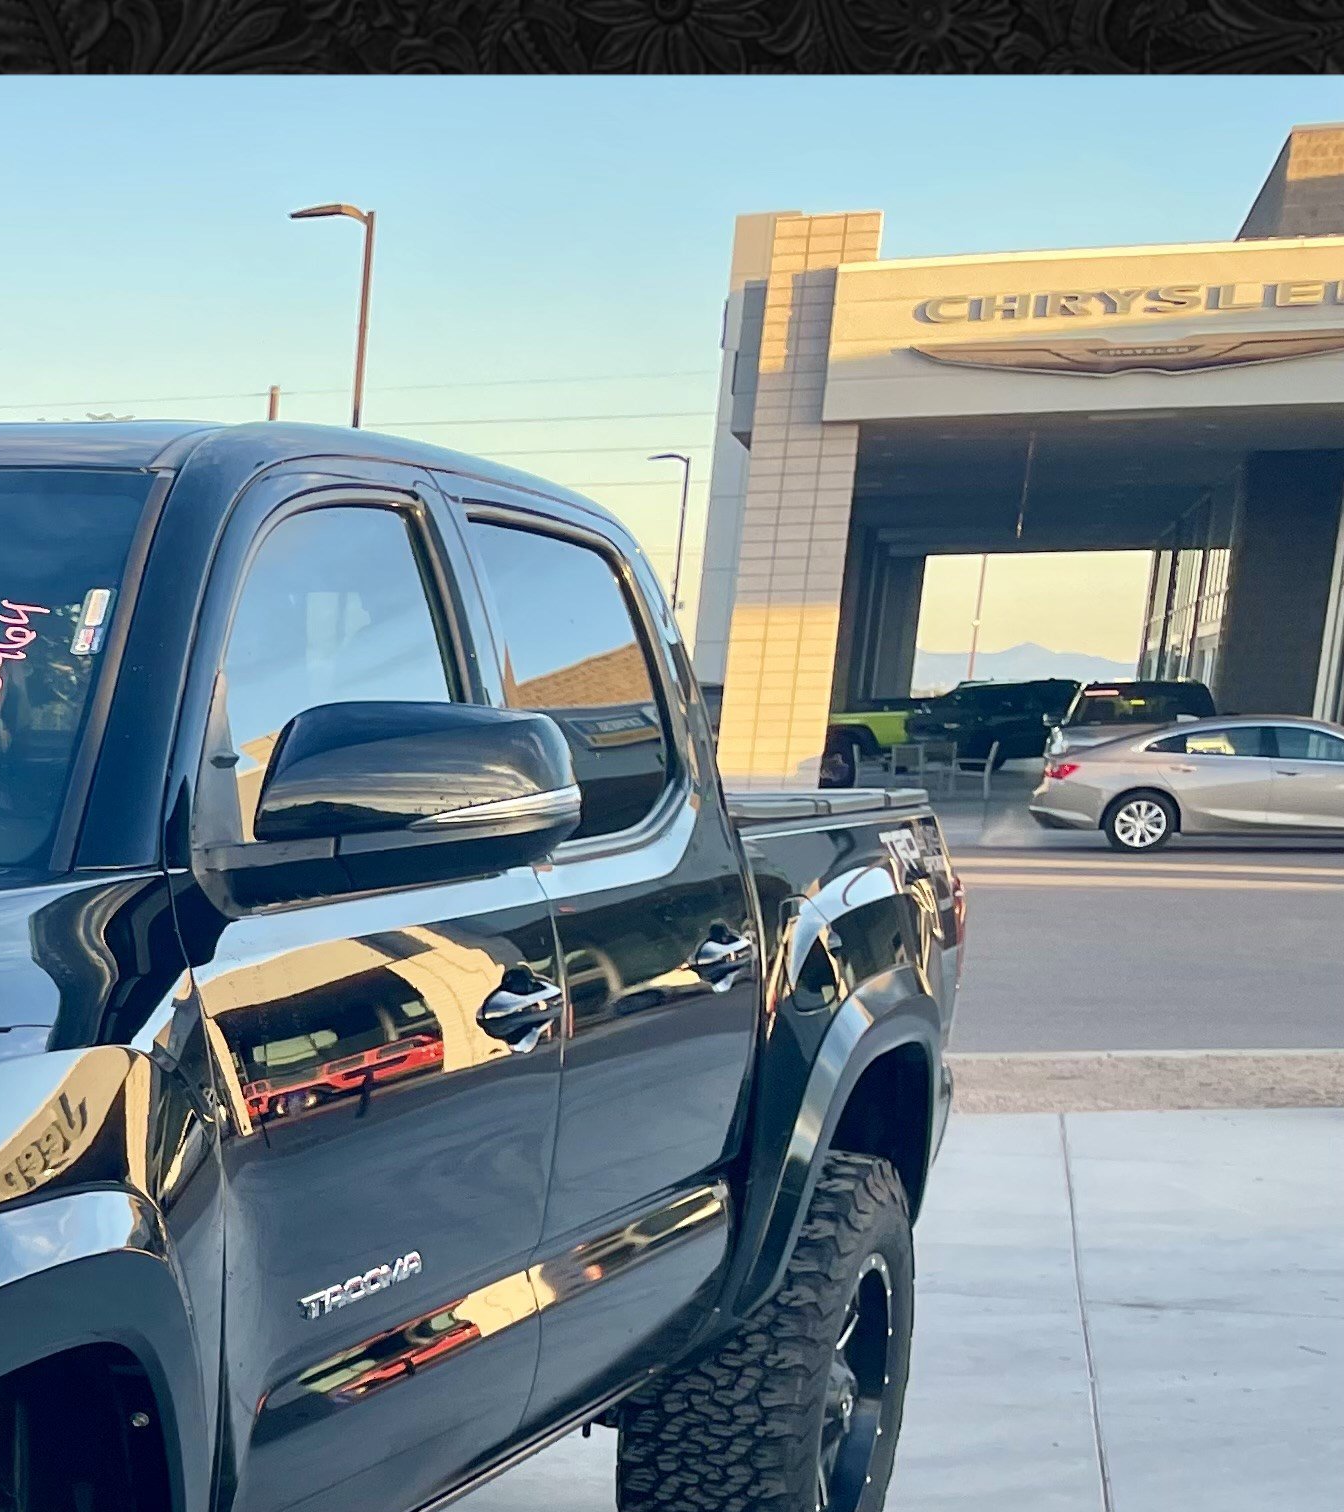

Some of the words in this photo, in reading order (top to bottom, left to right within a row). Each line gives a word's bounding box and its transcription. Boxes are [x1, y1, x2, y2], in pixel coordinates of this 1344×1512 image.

[913, 279, 1344, 324] CHRYSLE
[879, 829, 920, 871] TRD
[298, 1251, 423, 1319] TACOMA
